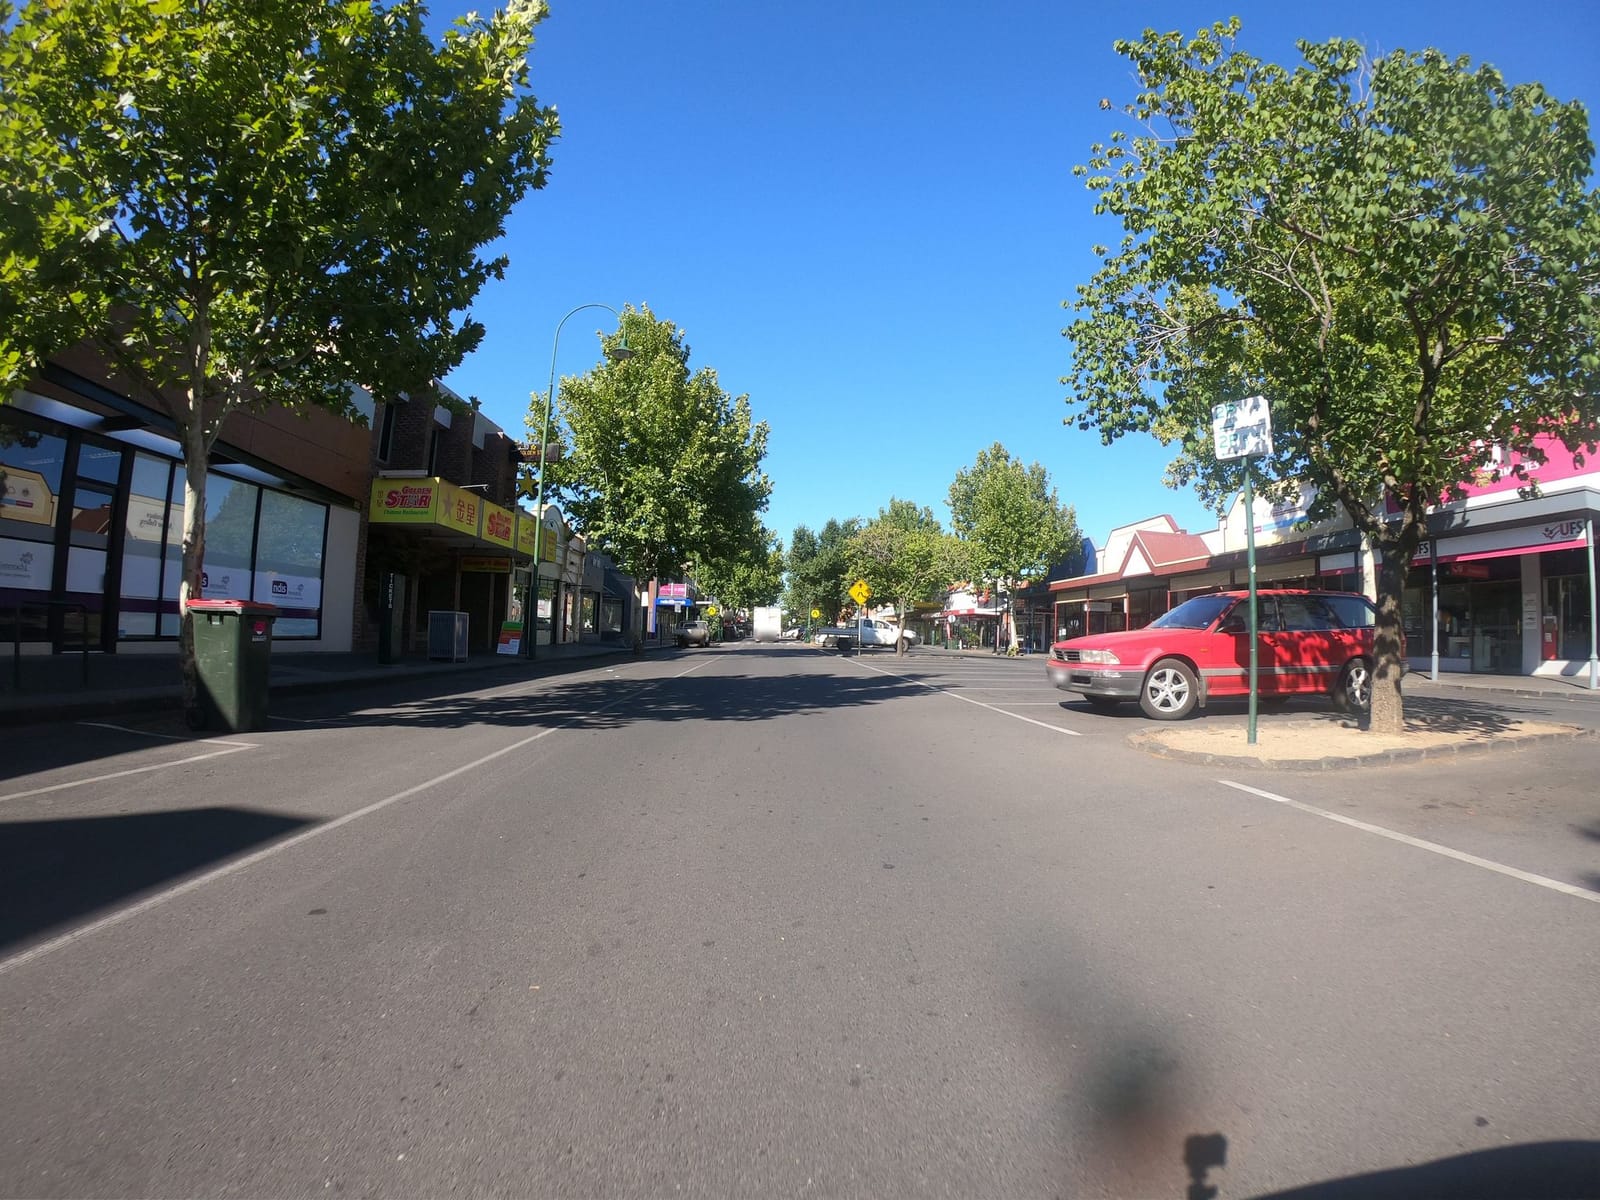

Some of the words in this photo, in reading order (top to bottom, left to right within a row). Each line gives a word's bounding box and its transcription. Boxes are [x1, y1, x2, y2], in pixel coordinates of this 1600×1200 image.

[385, 490, 431, 508] STAR
[1560, 520, 1583, 536] UFS
[1415, 542, 1429, 554] FS
[272, 583, 286, 593] ndis
